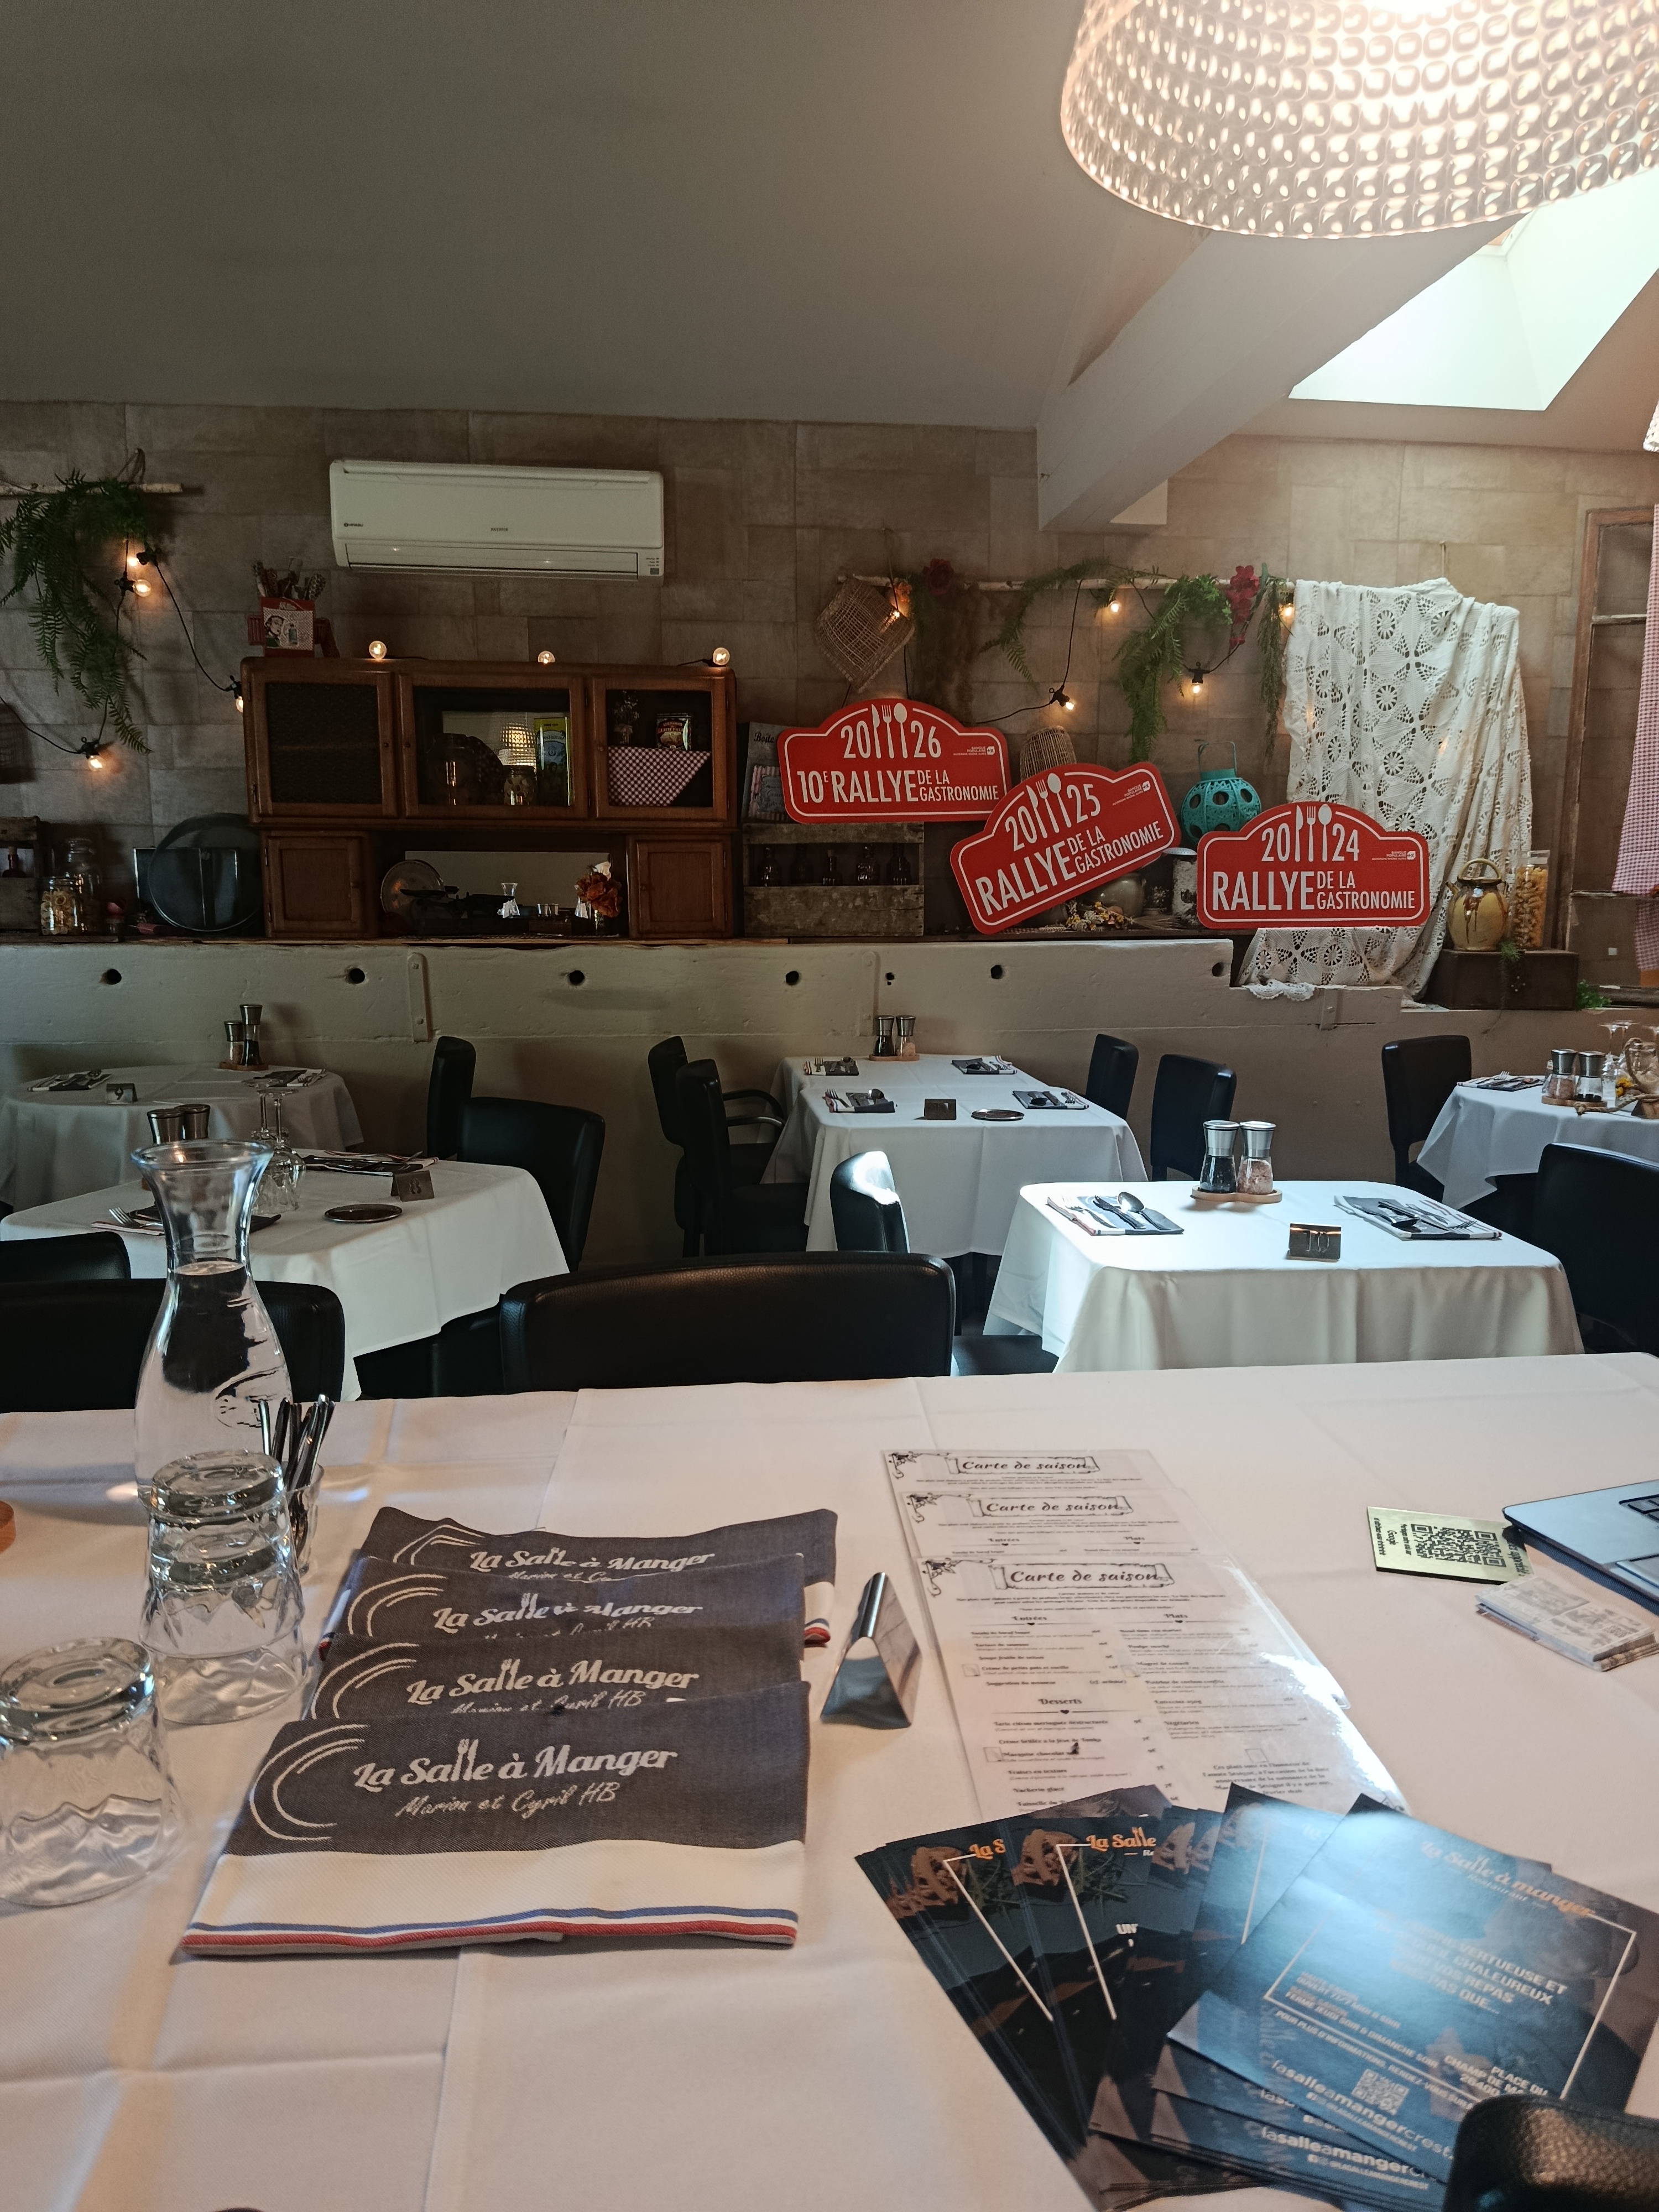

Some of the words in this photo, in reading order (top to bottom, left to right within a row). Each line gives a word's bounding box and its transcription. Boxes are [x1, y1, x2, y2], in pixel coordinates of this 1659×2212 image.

[831, 770, 919, 803] RALLYE
[917, 769, 932, 785] DE
[935, 769, 950, 785] LA
[920, 785, 999, 802] GASTRONOMIE
[1066, 832, 1084, 855] DE
[1087, 826, 1105, 847] LA
[1074, 821, 1164, 874] GASTRONOMIE
[975, 841, 1077, 916] RALLYE
[1213, 871, 1315, 911] RALLYE
[1317, 871, 1334, 889] DE
[1339, 870, 1356, 889] LA
[1317, 891, 1415, 910] GASTRONOMIE
[962, 1460, 1011, 1471] Carte
[1014, 1460, 1031, 1471] de
[1036, 1461, 1088, 1470] saison
[986, 1502, 1035, 1513] Carte
[1041, 1501, 1060, 1512] de
[1065, 1502, 1120, 1512] saison
[1386, 1530, 1399, 1545] Google
[469, 1551, 503, 1573] La
[504, 1547, 578, 1568] Salle
[607, 1553, 716, 1572] Manger
[1010, 1570, 1065, 1584] Carte
[1072, 1569, 1093, 1583] de
[1098, 1571, 1160, 1583] saison
[432, 1607, 469, 1634] La
[473, 1593, 551, 1627] Salle
[406, 1679, 445, 1705] La
[448, 1659, 535, 1698] Salle
[537, 1667, 565, 1689] à
[568, 1659, 700, 1690] Manger
[608, 1689, 648, 1708] HB
[352, 1762, 397, 1793] La
[400, 1738, 495, 1785] Salle
[497, 1752, 529, 1780] à
[533, 1744, 679, 1776] Manger
[394, 1794, 472, 1818] Marion
[477, 1794, 507, 1810] et
[510, 1784, 578, 1820] Cyril
[578, 1781, 621, 1807] HB
[969, 1844, 994, 1860] La
[1086, 1835, 1110, 1853] La
[1111, 1826, 1157, 1848] Salle
[1444, 1850, 1495, 1877] Salle
[1452, 1955, 1553, 2006] CHALEUREUX
[1458, 1942, 1545, 1986] VERTUEUSE
[1544, 1979, 1568, 1995] ET
[1427, 1974, 1459, 1995] PAS
[1465, 1974, 1516, 2005] REPAS
[1367, 2030, 1416, 2058] DIMANCHE
[1444, 2054, 1488, 2078] CHAMP
[1486, 2074, 1504, 2089] DE
[1491, 2065, 1530, 2090] PLACE
[1272, 2059, 1454, 2161] lasalleamangercrest.
